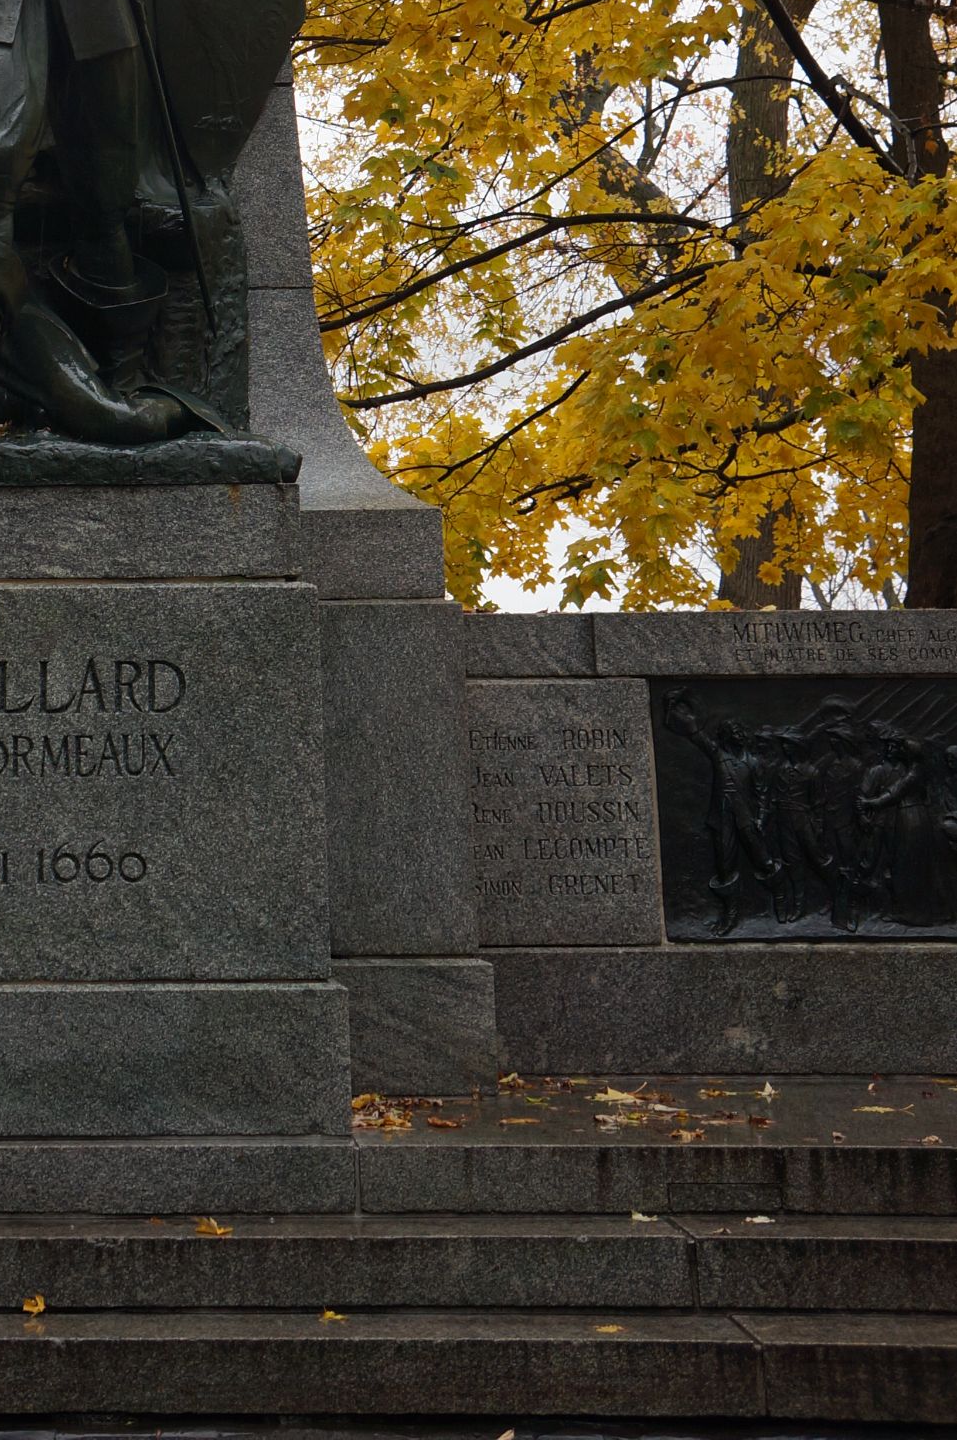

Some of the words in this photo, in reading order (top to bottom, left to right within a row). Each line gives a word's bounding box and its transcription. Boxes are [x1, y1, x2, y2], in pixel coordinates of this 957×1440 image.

[876, 629, 919, 643] CHEF
[735, 649, 754, 661] ET
[836, 648, 857, 661] DE
[868, 647, 899, 661] SES
[562, 729, 627, 750] ROBIN
[538, 765, 633, 787] VALETS
[538, 801, 640, 824] DOUSSIN
[473, 844, 504, 860] EAN
[524, 838, 650, 860] LECOMPTE
[36, 839, 147, 884] 1660
[549, 874, 641, 896] GRENET
